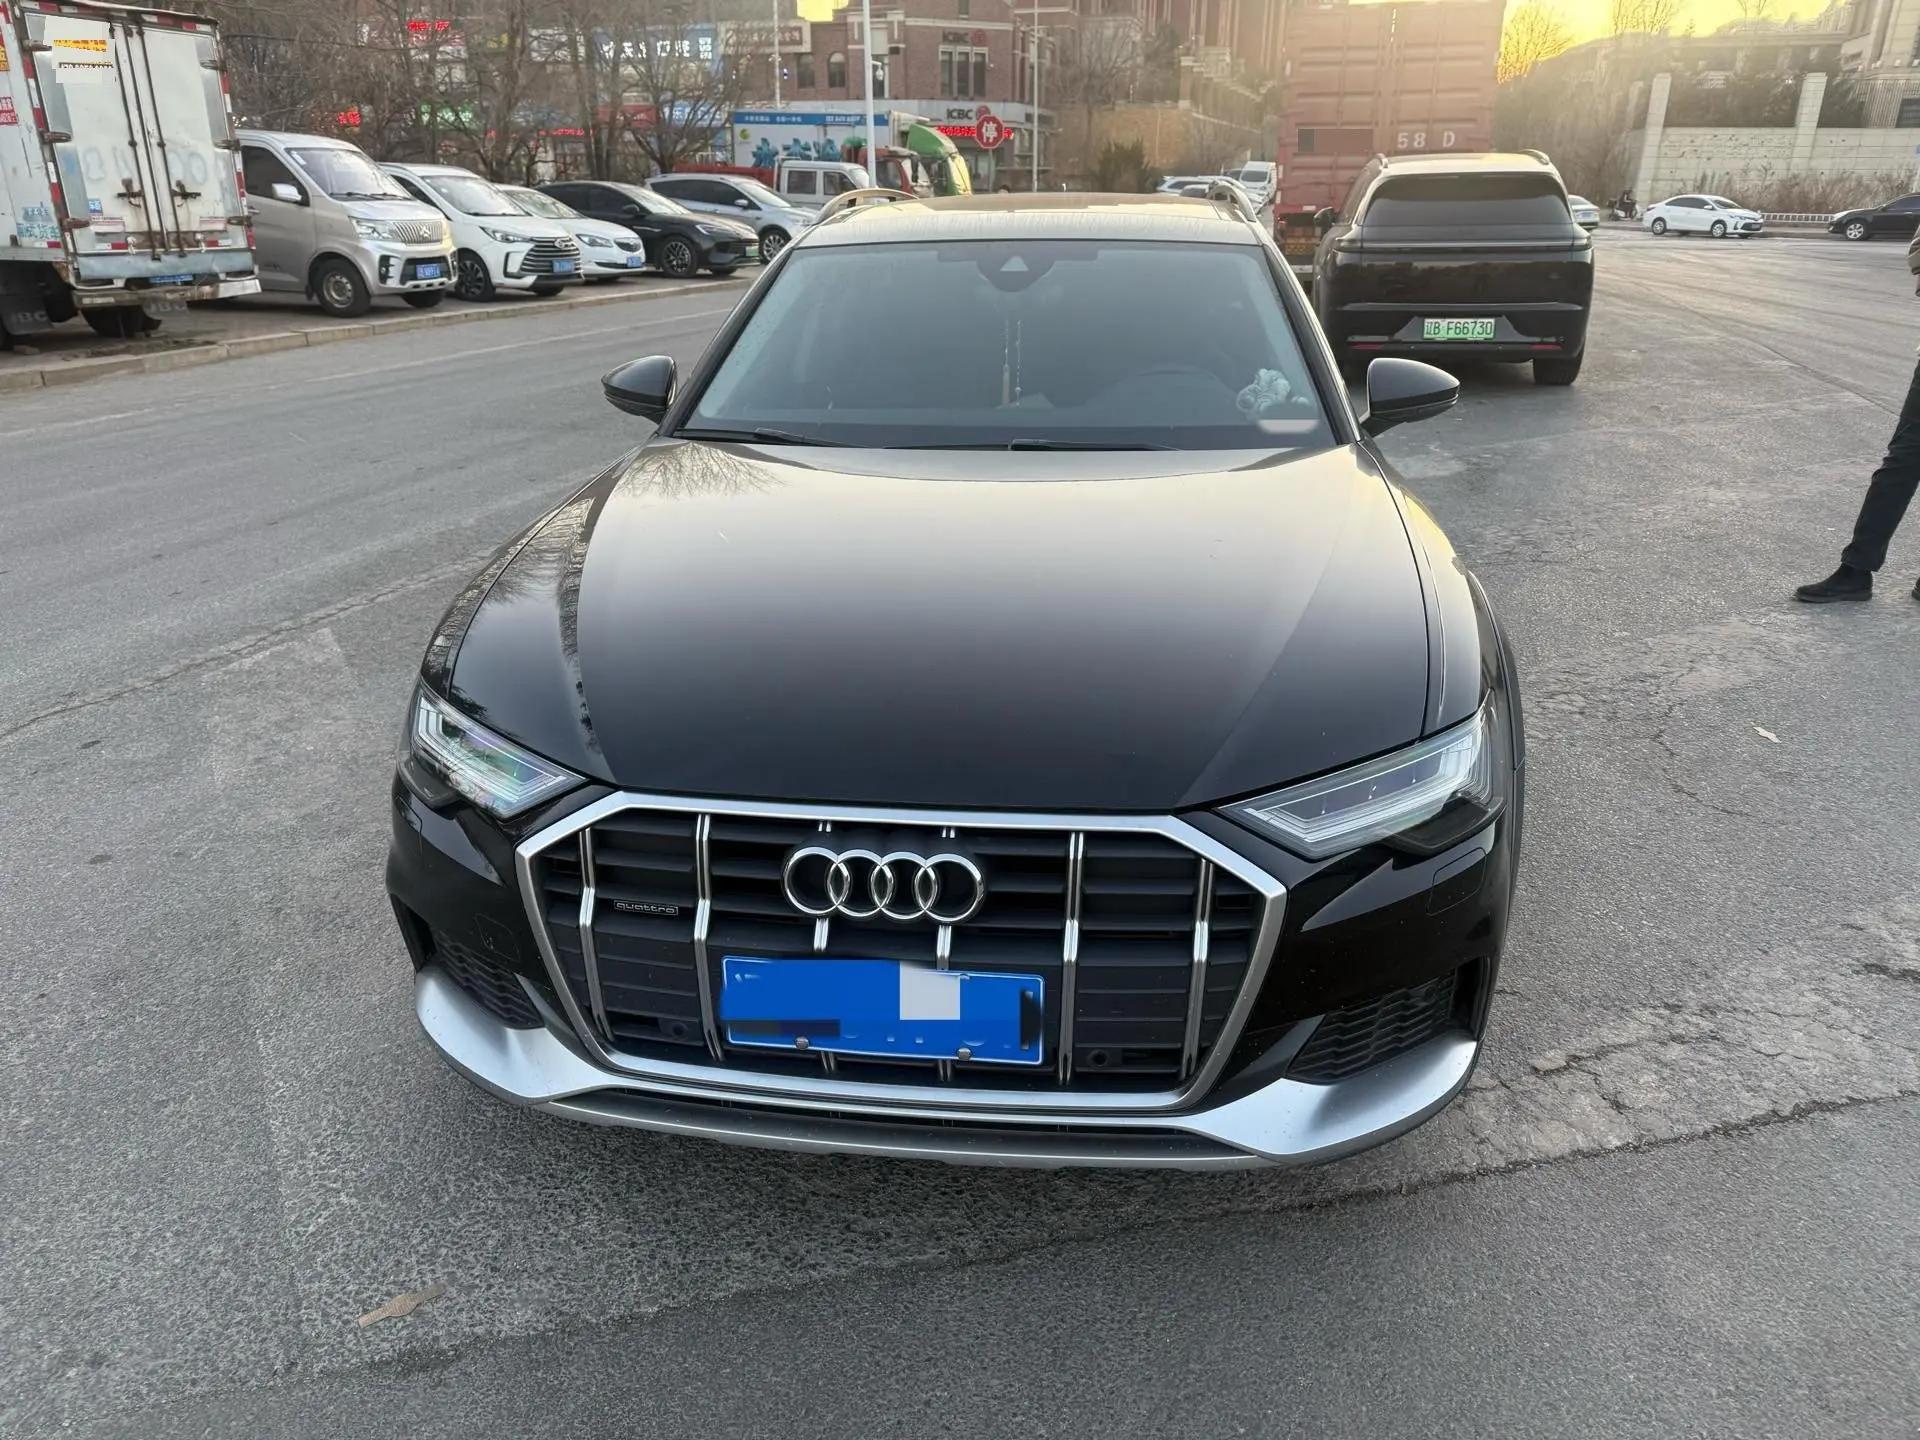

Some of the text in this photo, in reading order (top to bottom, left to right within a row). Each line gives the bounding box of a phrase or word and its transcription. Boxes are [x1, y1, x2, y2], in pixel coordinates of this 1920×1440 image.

[947, 108, 973, 120] ICBC
[982, 121, 998, 143] 停
[1397, 130, 1456, 149] 58 D
[616, 902, 675, 914] quattro
